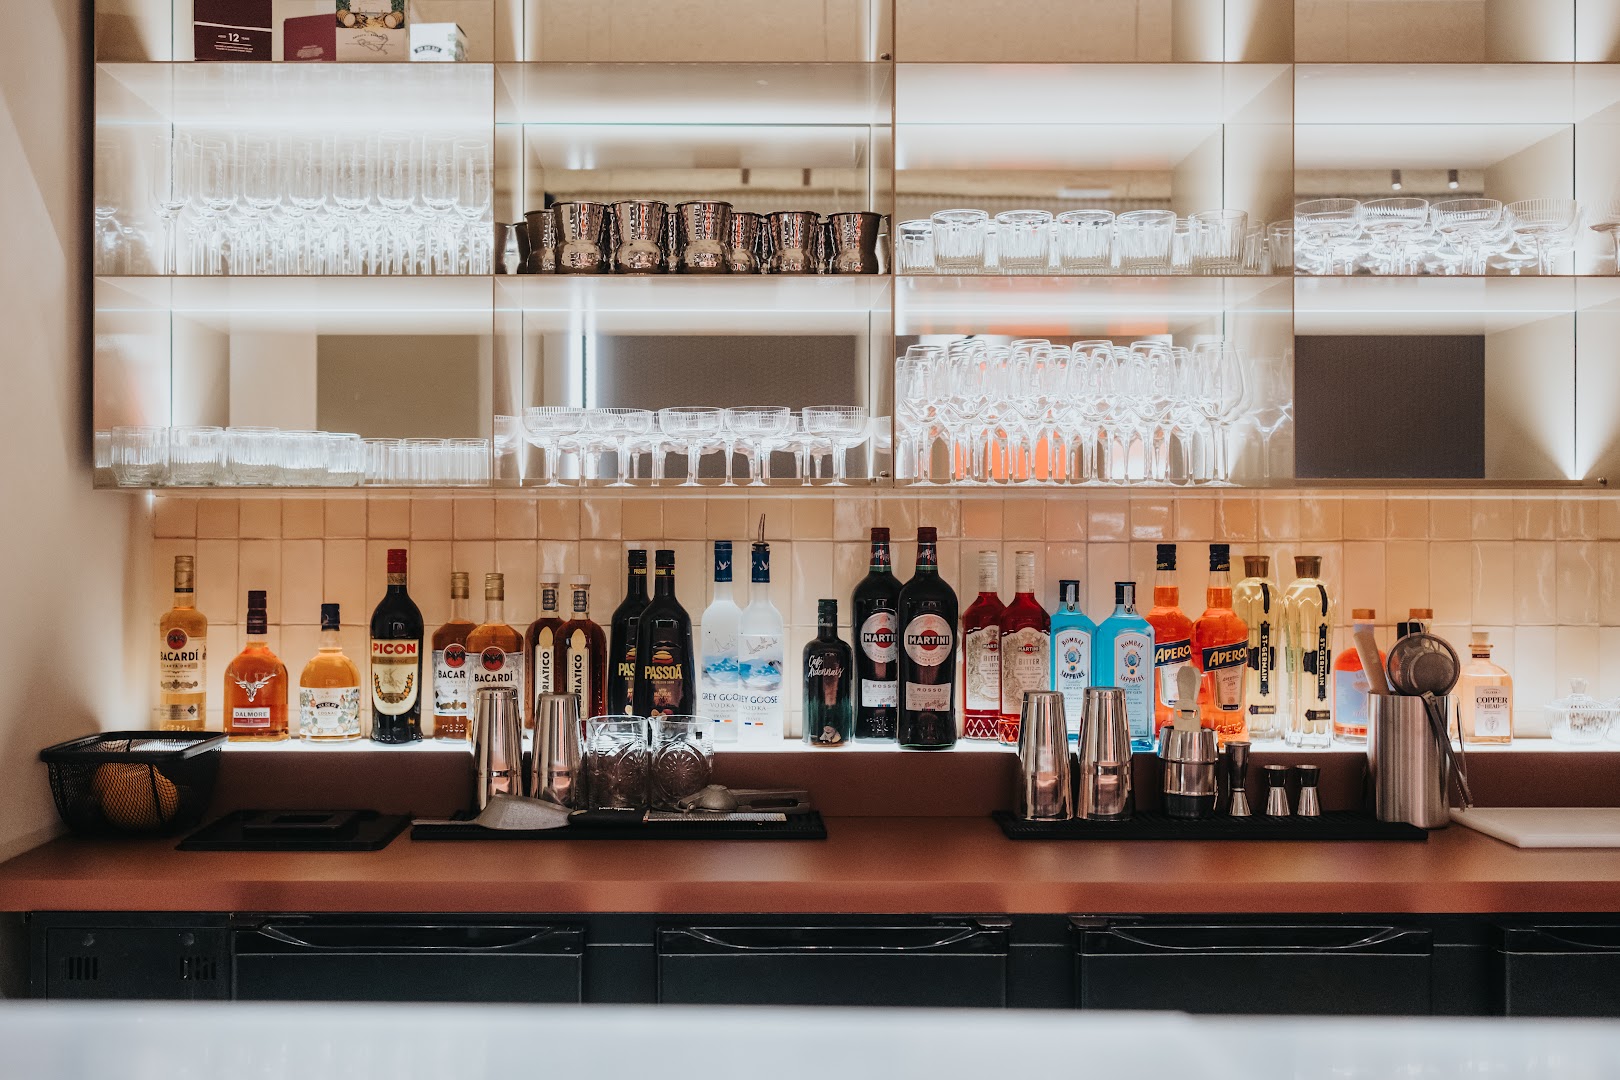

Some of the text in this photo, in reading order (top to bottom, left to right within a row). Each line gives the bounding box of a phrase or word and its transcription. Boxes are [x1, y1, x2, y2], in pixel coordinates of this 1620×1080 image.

[228, 33, 239, 42] 12
[864, 634, 894, 642] MARTI
[909, 636, 949, 645] MARTINI
[1062, 637, 1084, 647] BOMBAY
[373, 643, 416, 654] PICON
[1120, 640, 1144, 650] BOMBAY
[160, 649, 198, 661] BACARDÍ
[1155, 645, 1191, 662] APERO
[1209, 647, 1247, 667] APEROL
[618, 662, 636, 677] PAS
[1061, 670, 1086, 679] SAPPHIRE
[474, 671, 513, 682] BACARDÍ
[1120, 674, 1145, 683] SAPPHIRE
